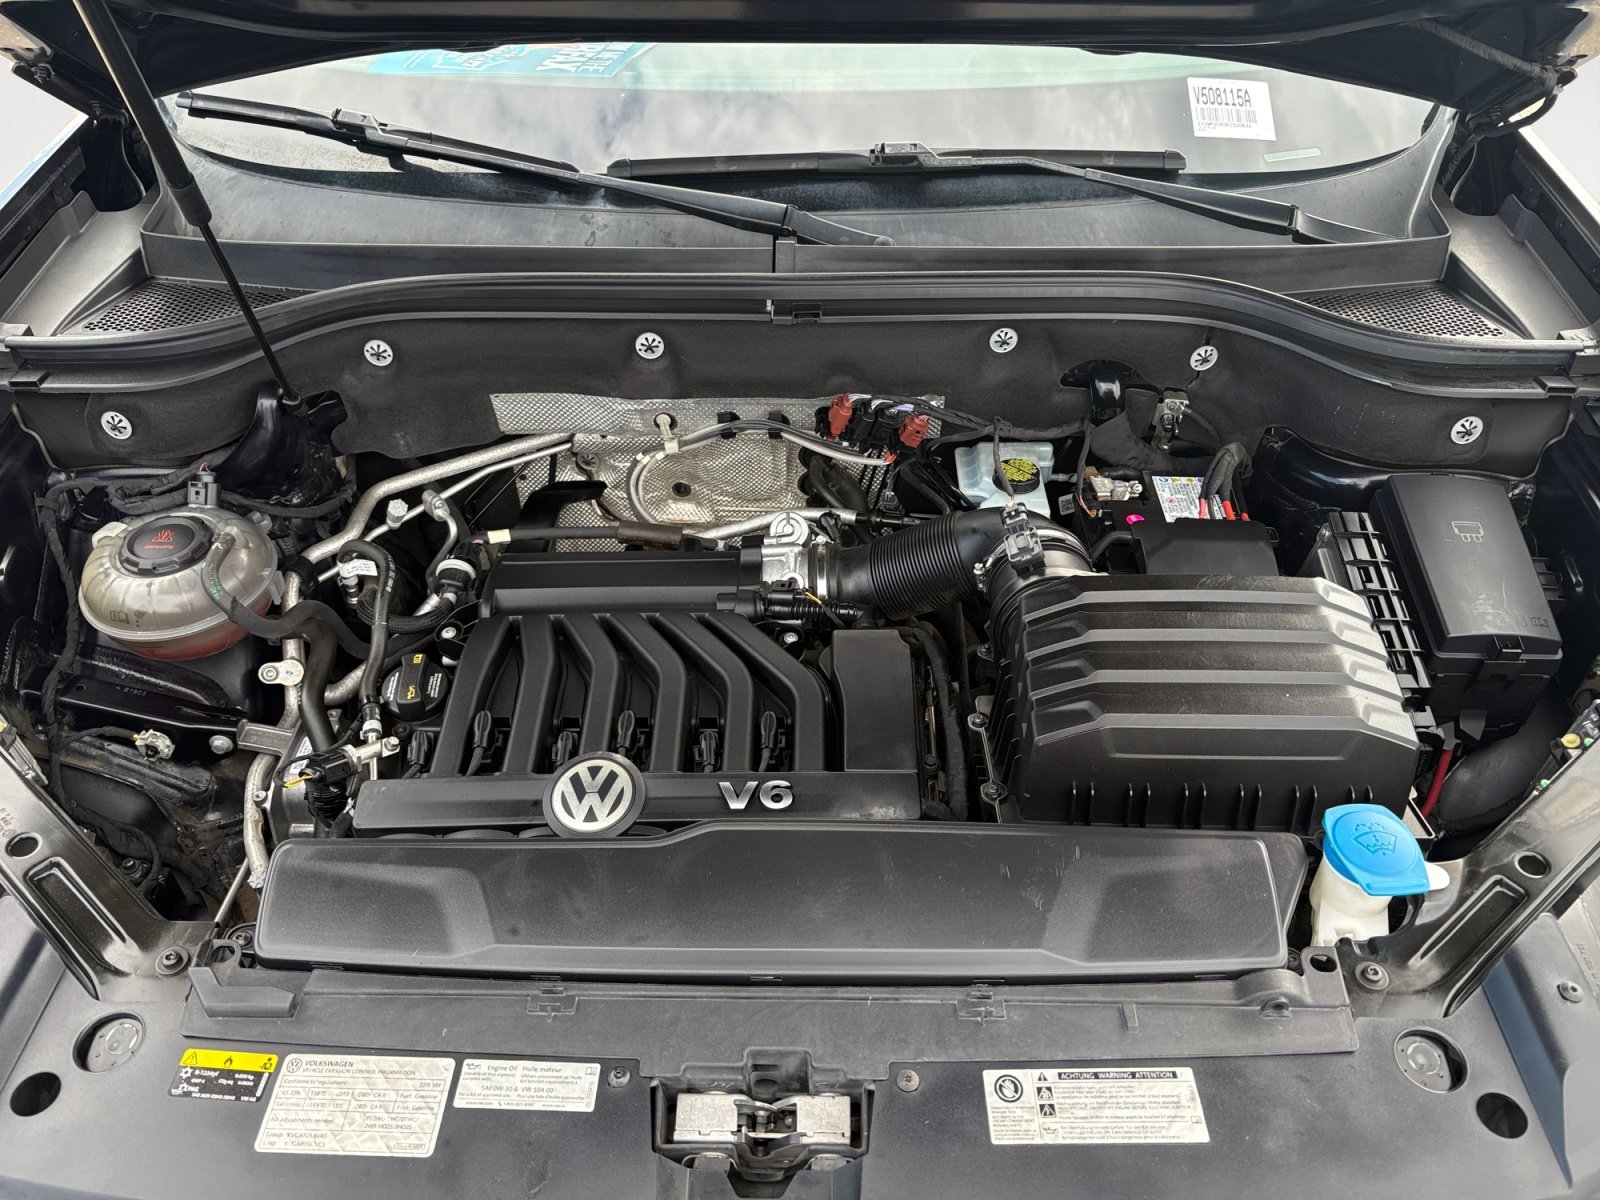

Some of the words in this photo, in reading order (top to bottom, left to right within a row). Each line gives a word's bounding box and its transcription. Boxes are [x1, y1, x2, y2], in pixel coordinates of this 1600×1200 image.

[1193, 86, 1252, 108] V508115A
[718, 780, 794, 810] V6
[305, 1060, 354, 1068] VOLKSWAGEN
